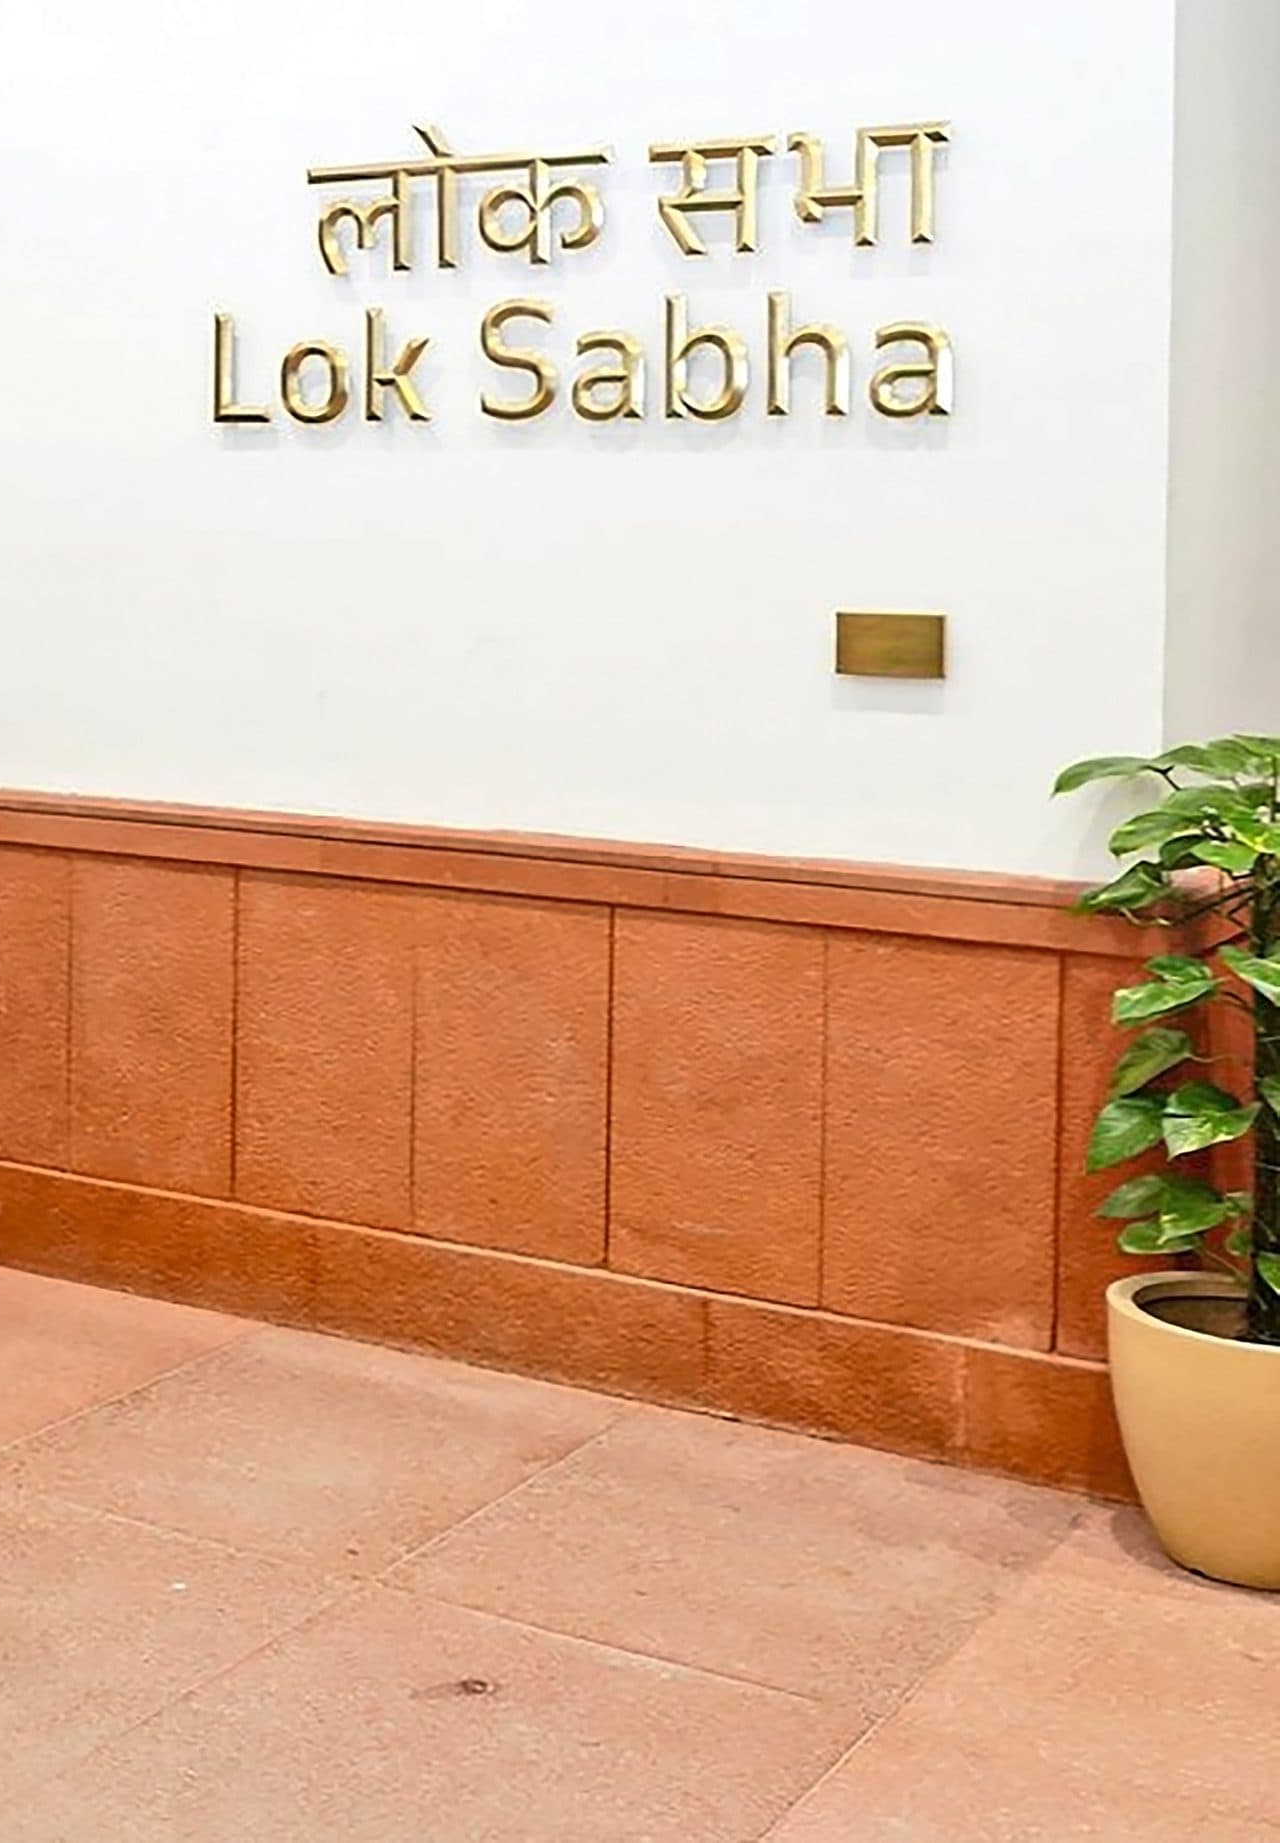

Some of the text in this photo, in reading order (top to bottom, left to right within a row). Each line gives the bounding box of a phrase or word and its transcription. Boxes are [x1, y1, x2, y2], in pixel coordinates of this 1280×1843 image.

[306, 120, 951, 276] लोक सभा
[212, 292, 952, 423] Lok Sabha
